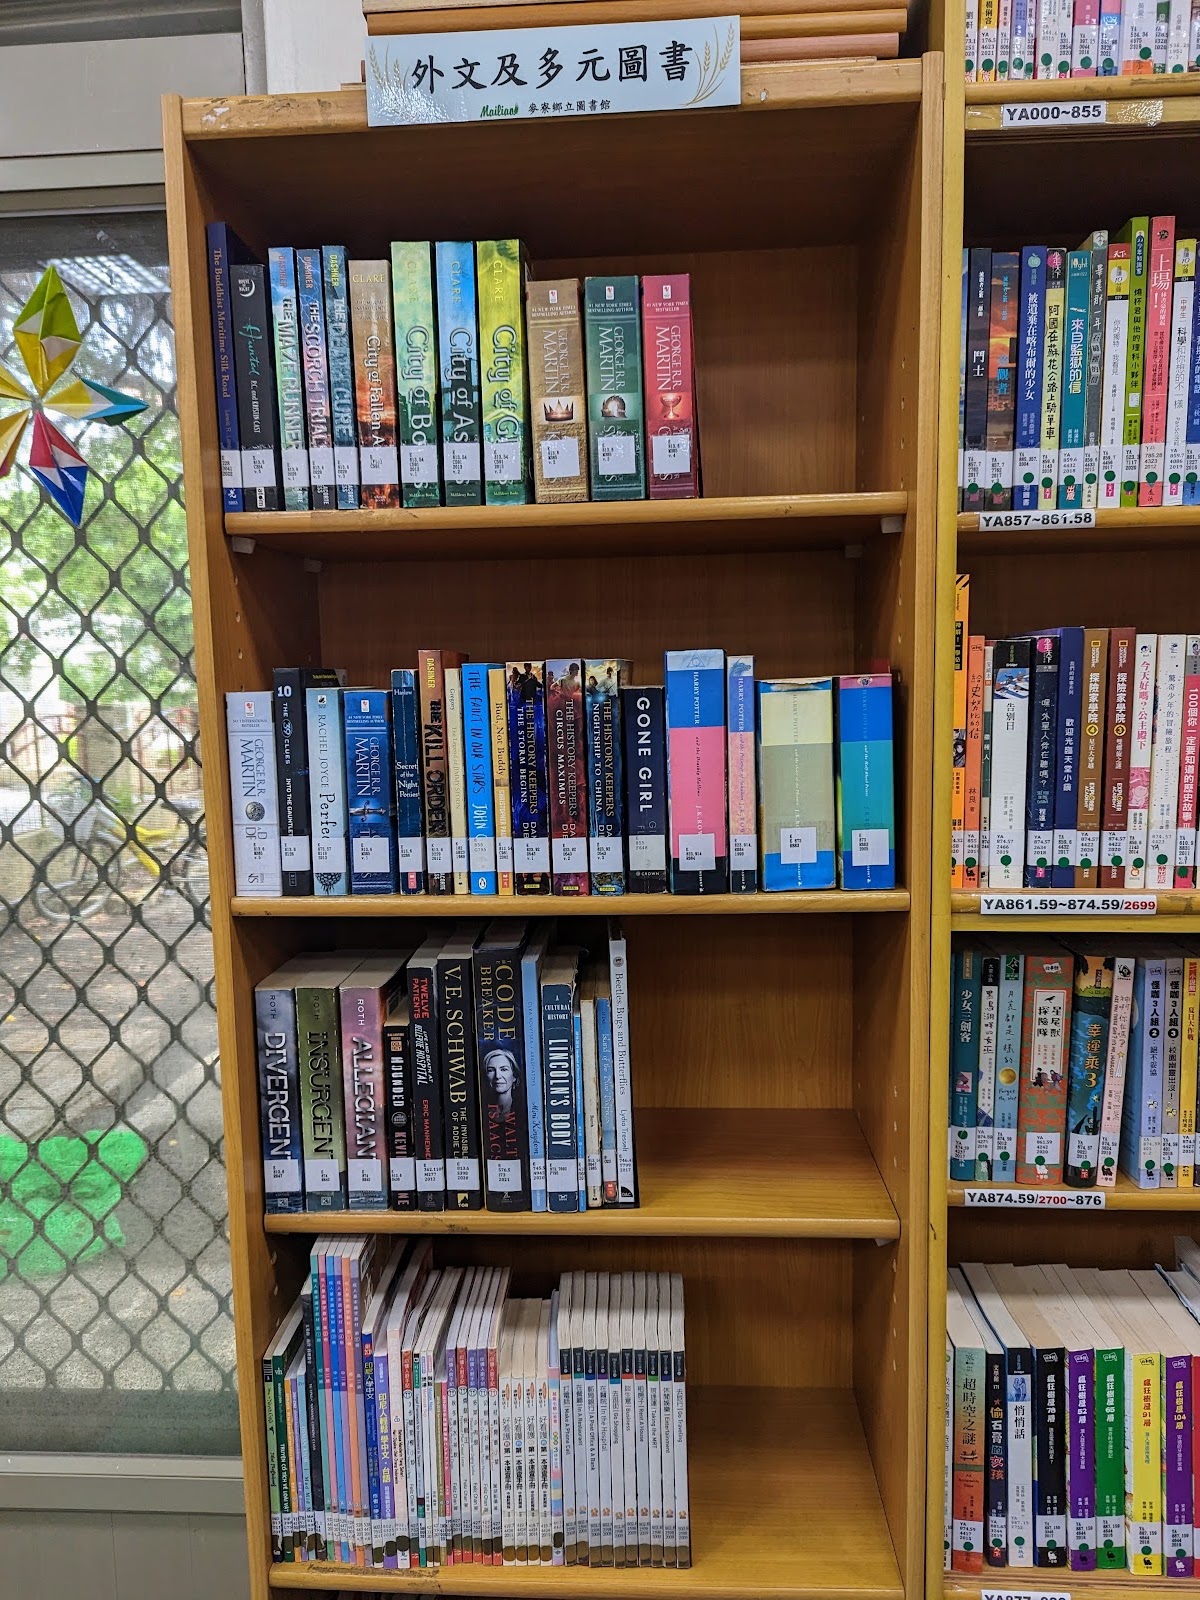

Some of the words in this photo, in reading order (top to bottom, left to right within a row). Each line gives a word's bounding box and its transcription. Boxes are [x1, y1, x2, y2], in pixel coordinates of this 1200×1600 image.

[412, 40, 693, 94] 外文及多元圖書
[480, 103, 514, 117] Mailiao
[528, 100, 611, 114] 麥寮鄉立圖書館
[1007, 105, 1101, 120] YA000~855
[215, 268, 224, 309] Buddhist
[330, 254, 339, 286] DASHNER
[353, 274, 385, 283] CLARE
[493, 260, 504, 301] CLARE
[282, 298, 293, 321] THE
[309, 301, 320, 323] THE
[334, 298, 345, 322] THE
[217, 311, 227, 352] Maritime
[238, 318, 262, 376] Hunted
[279, 321, 296, 373] MAZE
[558, 329, 569, 370] GEORGE
[614, 326, 625, 368] GEORGE
[671, 325, 681, 369] GEORGE
[1025, 293, 1038, 400] 被遺棄在喀布爾的少女
[220, 354, 228, 372] Silk
[306, 323, 326, 392] SCORCH
[364, 335, 381, 367] City
[402, 325, 429, 382] City
[443, 328, 472, 382] City
[487, 325, 516, 384] City
[543, 330, 559, 393] MARTIN
[598, 327, 615, 391] MARTIN
[656, 327, 672, 391] MARTIN
[973, 350, 985, 377] 鬥士
[1068, 318, 1084, 394] 來自監獄的信
[222, 375, 231, 398] Road
[368, 371, 381, 383] of
[282, 377, 303, 449] RUNNER
[334, 388, 353, 436] CURE
[369, 387, 385, 431] Fallen
[408, 386, 429, 407] of
[452, 387, 472, 408] of
[494, 389, 517, 409] of
[983, 513, 1092, 527] YA857~861.58
[277, 686, 292, 697] 10
[427, 658, 435, 689] DASHNER
[468, 670, 480, 690] THE
[471, 696, 483, 724] FAULT
[495, 702, 503, 724] Bud,
[525, 697, 534, 719] THE
[565, 699, 573, 720] THE
[603, 699, 611, 720] THE
[1088, 672, 1100, 723] 探險家學院
[1115, 672, 1127, 723] 探險家學院
[282, 721, 292, 736] 39
[318, 714, 328, 755] RACHEL
[473, 728, 482, 739] IN
[556, 709, 564, 749] CIRCUS
[593, 703, 601, 758] NIGHTSHIP
[637, 697, 651, 756] GONE
[1006, 703, 1015, 731] 告別日
[254, 739, 265, 778] GEORGE
[369, 737, 380, 776] GEORGE
[424, 724, 443, 766] KILL
[472, 742, 484, 759] OUR
[496, 747, 505, 777] Buddy
[518, 730, 526, 764] STORM
[527, 721, 536, 767] HISTORY
[566, 723, 576, 768] HISTORY
[604, 723, 613, 769] HISTORY
[1063, 718, 1074, 792] 歡迎光臨天堂小鎮
[240, 739, 256, 798] MARTIN
[319, 758, 329, 788] JOYCE
[354, 737, 371, 796] MARTIN
[397, 762, 417, 770] Secret
[472, 763, 486, 794] STARS
[558, 754, 566, 804] MAXIMUS
[595, 762, 601, 775] TO
[398, 781, 418, 789] Night
[426, 768, 444, 835] ORDER
[520, 768, 528, 803] BEGINS
[529, 770, 538, 814] KEEPERS
[568, 772, 577, 816] KEEPERS
[605, 772, 614, 817] KEEPERS
[639, 768, 652, 812] GIRL
[473, 804, 488, 829] JOHN
[984, 899, 1155, 910] YA861.59~874.59/2699
[444, 966, 461, 980] V.
[422, 978, 430, 1018] TWELVE
[446, 986, 461, 1004] E.
[479, 966, 495, 1041] BREAKER
[495, 964, 515, 1041] CODE
[615, 1007, 623, 1029] Bugs
[960, 990, 973, 1043] 少女三劍客
[1037, 1006, 1049, 1037] 探險隊
[1050, 1006, 1061, 1037] 星尾獸
[417, 1050, 428, 1085] HOSPITAL
[447, 1009, 466, 1103] SCHWAB
[548, 1039, 569, 1106] LINCOLN'S
[390, 1057, 404, 1107] HOUNDED
[428, 1075, 433, 1083] AT
[452, 1112, 458, 1122] OF
[550, 1114, 571, 1147] BODY
[531, 1120, 541, 1155] Kingdom
[968, 1193, 1101, 1205] YA874.59/2700~876
[962, 1378, 976, 1445] 超時空之謎
[1014, 1405, 1025, 1439] 悄悄話
[990, 1407, 1004, 1480] 偷石膏的女孩
